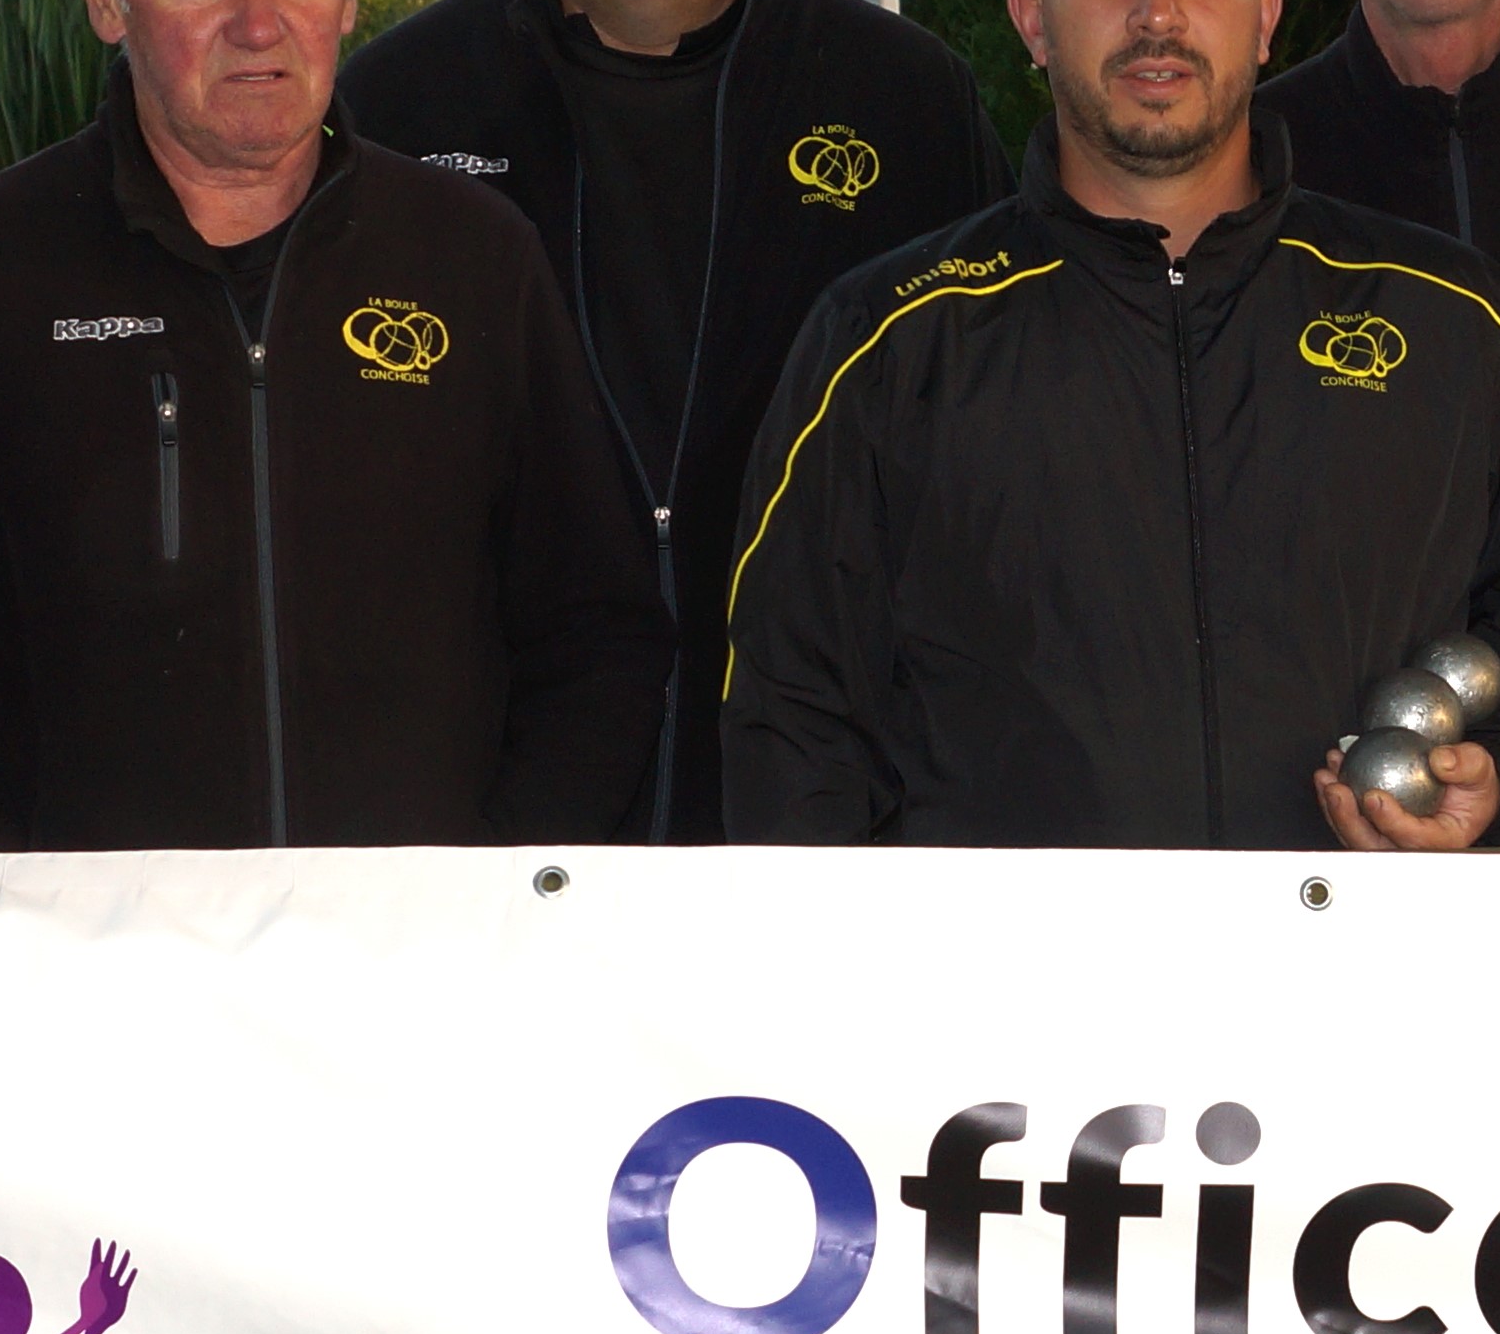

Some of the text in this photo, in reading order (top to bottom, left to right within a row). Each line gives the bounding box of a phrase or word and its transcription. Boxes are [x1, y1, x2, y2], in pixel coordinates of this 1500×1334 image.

[812, 125, 825, 135] LA
[368, 296, 419, 310] LA BOULE
[1319, 310, 1372, 323] LA BOULE
[52, 316, 165, 341] Kappa
[360, 368, 430, 385] CONCHOISE
[1320, 376, 1388, 393] CONCHOISE
